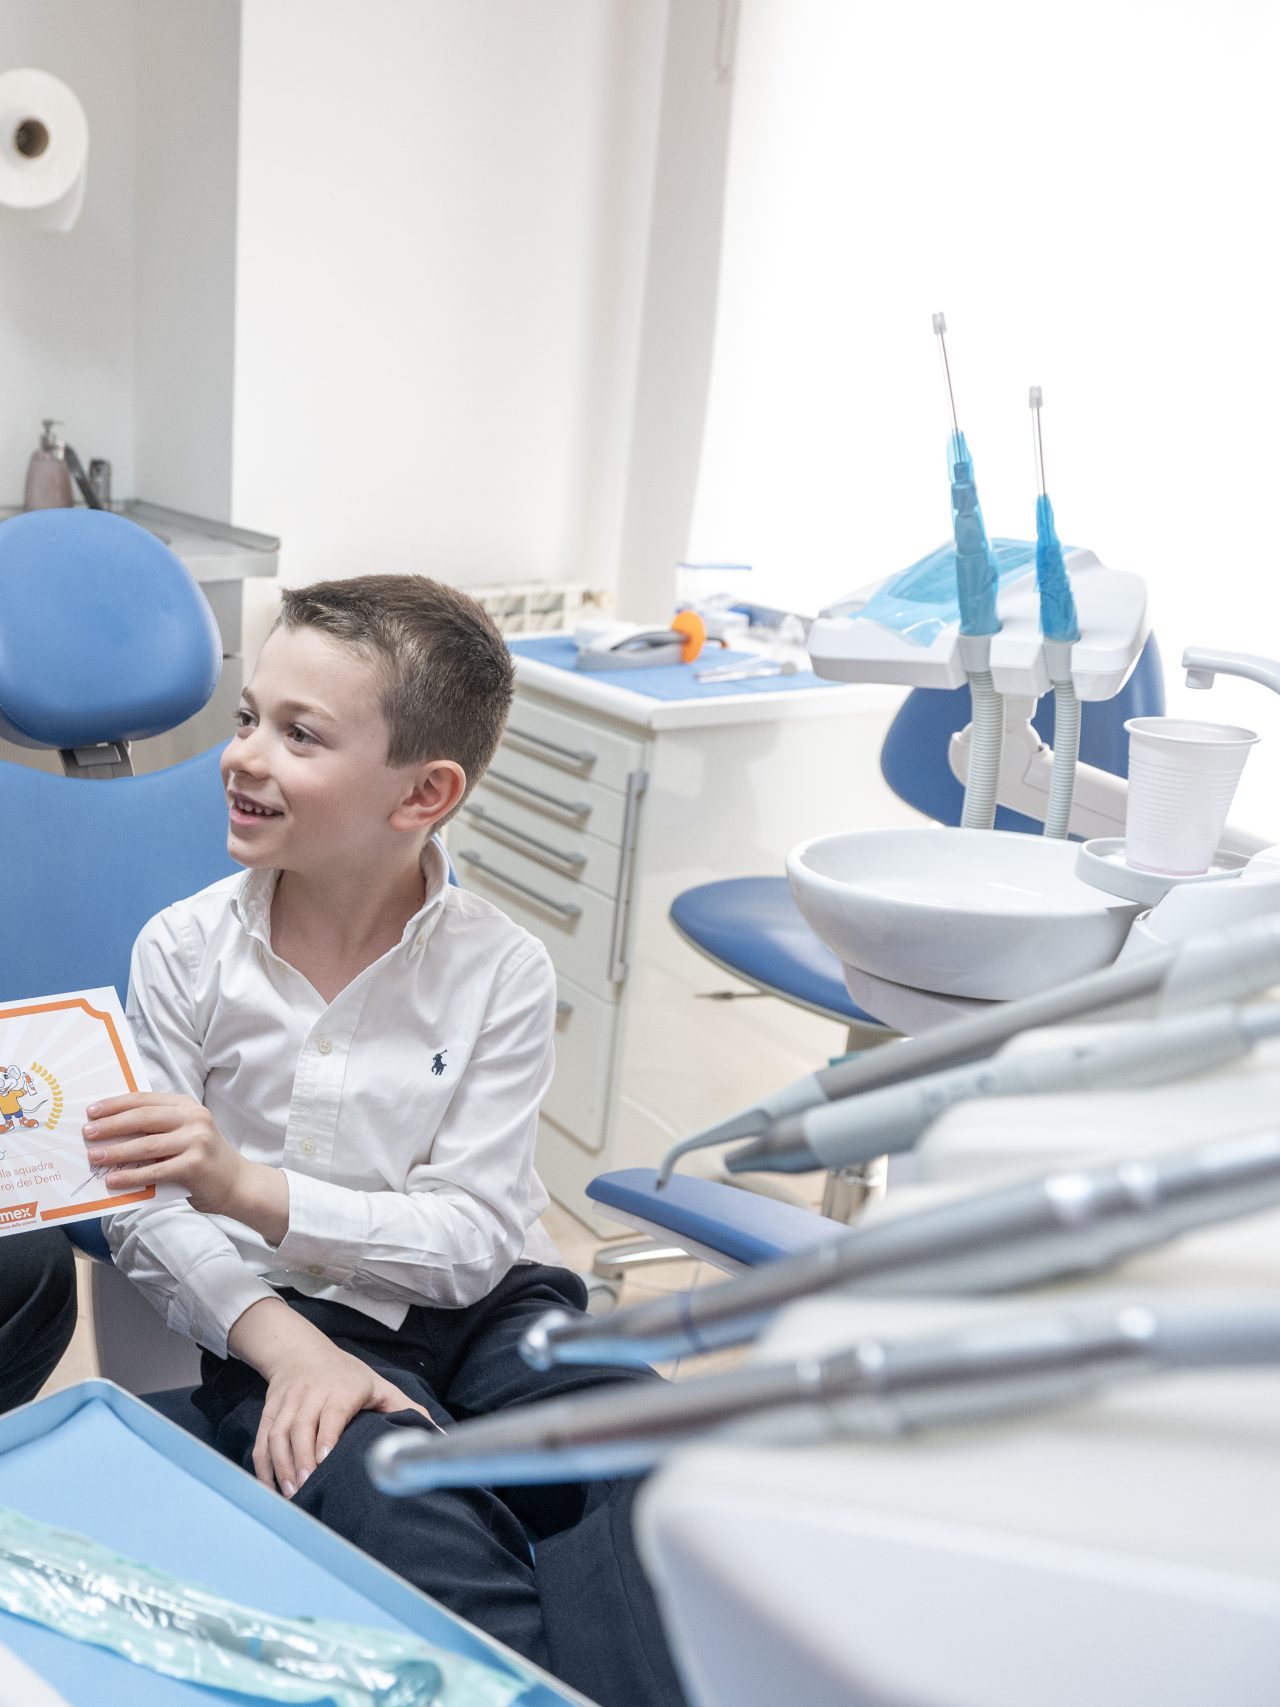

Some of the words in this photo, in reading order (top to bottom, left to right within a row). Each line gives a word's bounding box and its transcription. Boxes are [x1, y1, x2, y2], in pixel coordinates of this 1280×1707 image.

[13, 1161, 54, 1177] squadra
[16, 1176, 33, 1188] dei
[34, 1170, 62, 1185] Denti
